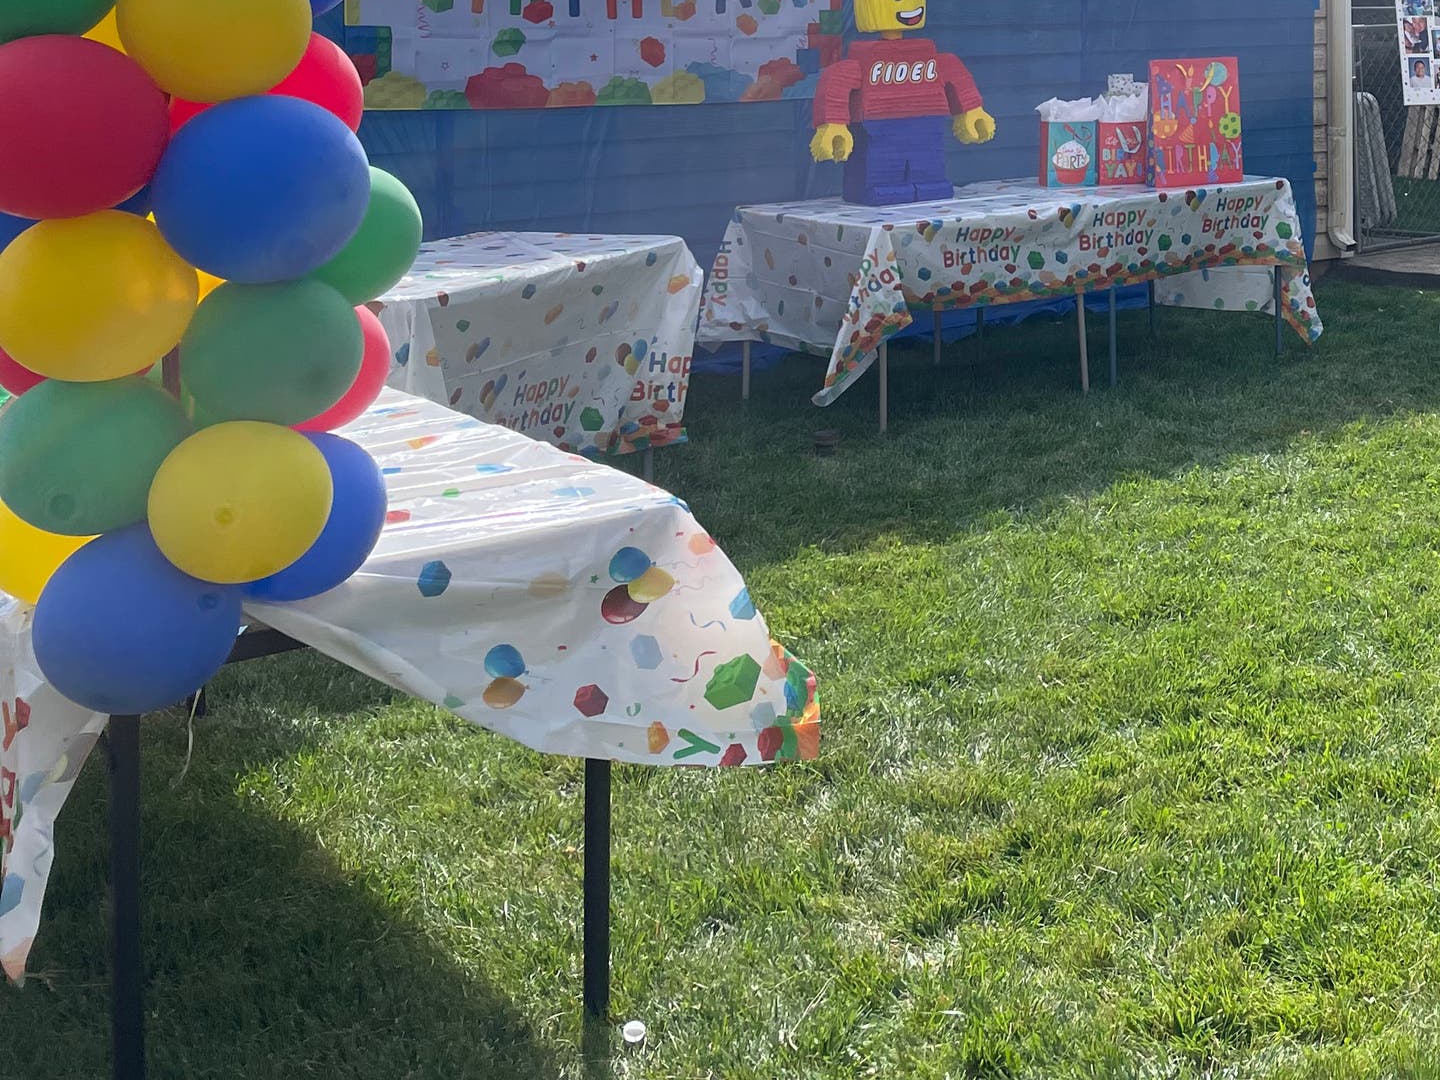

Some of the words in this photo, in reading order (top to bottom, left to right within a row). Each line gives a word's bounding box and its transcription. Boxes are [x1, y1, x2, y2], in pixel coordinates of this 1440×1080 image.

[870, 59, 937, 86] FIDEL
[1159, 85, 1233, 120] HAPPY
[1216, 195, 1264, 213] Happy
[1093, 209, 1147, 228] Happy
[1202, 213, 1270, 233] Birthday
[956, 226, 1016, 243] Happy
[1079, 229, 1154, 251] Birthday
[943, 245, 1020, 268] Birthday
[513, 374, 570, 406] Happy
